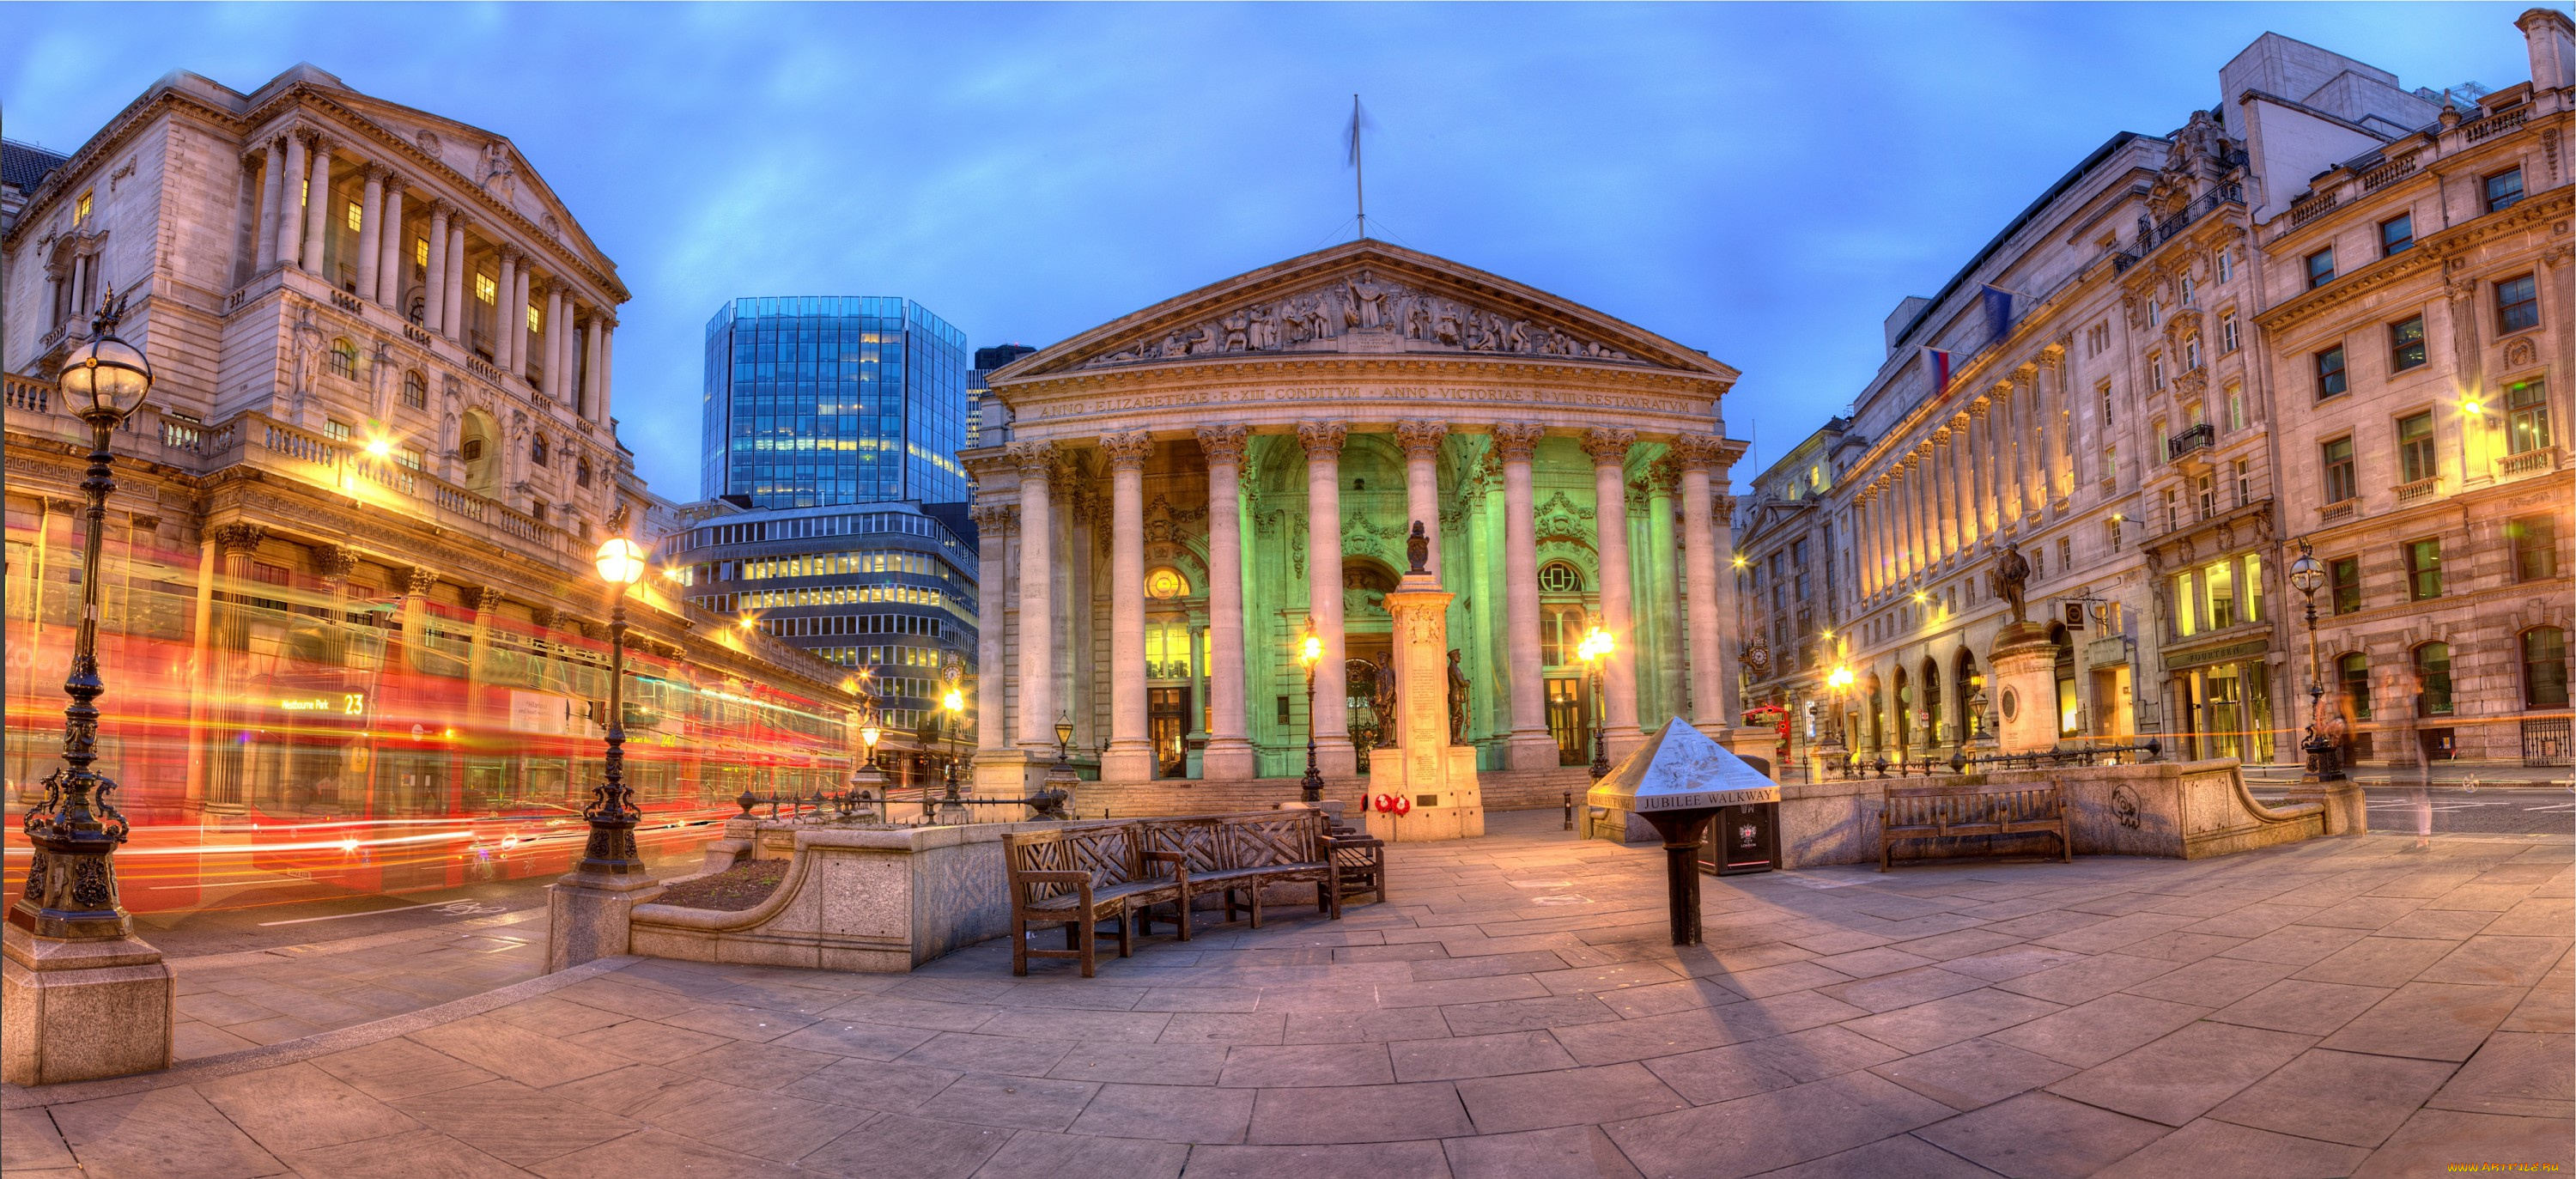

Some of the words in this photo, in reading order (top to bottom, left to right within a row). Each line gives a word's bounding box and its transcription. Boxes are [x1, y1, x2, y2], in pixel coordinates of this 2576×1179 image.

[1040, 403, 1084, 418] ANNO
[1096, 392, 1210, 412] ELIZABETHAE
[1220, 392, 1230, 402] R
[1240, 390, 1266, 401] XIII
[1274, 387, 1360, 399] CONDITVM
[1381, 386, 1429, 399] ANNO
[1438, 387, 1524, 401] VICTORIAE
[1533, 391, 1543, 402] R
[1552, 392, 1577, 404] VIII
[1585, 394, 1690, 413] RESTAVRATVM
[2190, 646, 2239, 662] FOURTEEN
[315, 698, 329, 710] Park
[344, 694, 363, 715] 23
[660, 734, 677, 747] 242
[1605, 796, 1632, 809] EXCHANGE
[1644, 794, 1701, 810] JUBILEE
[1708, 789, 1773, 804] WALKWAY
